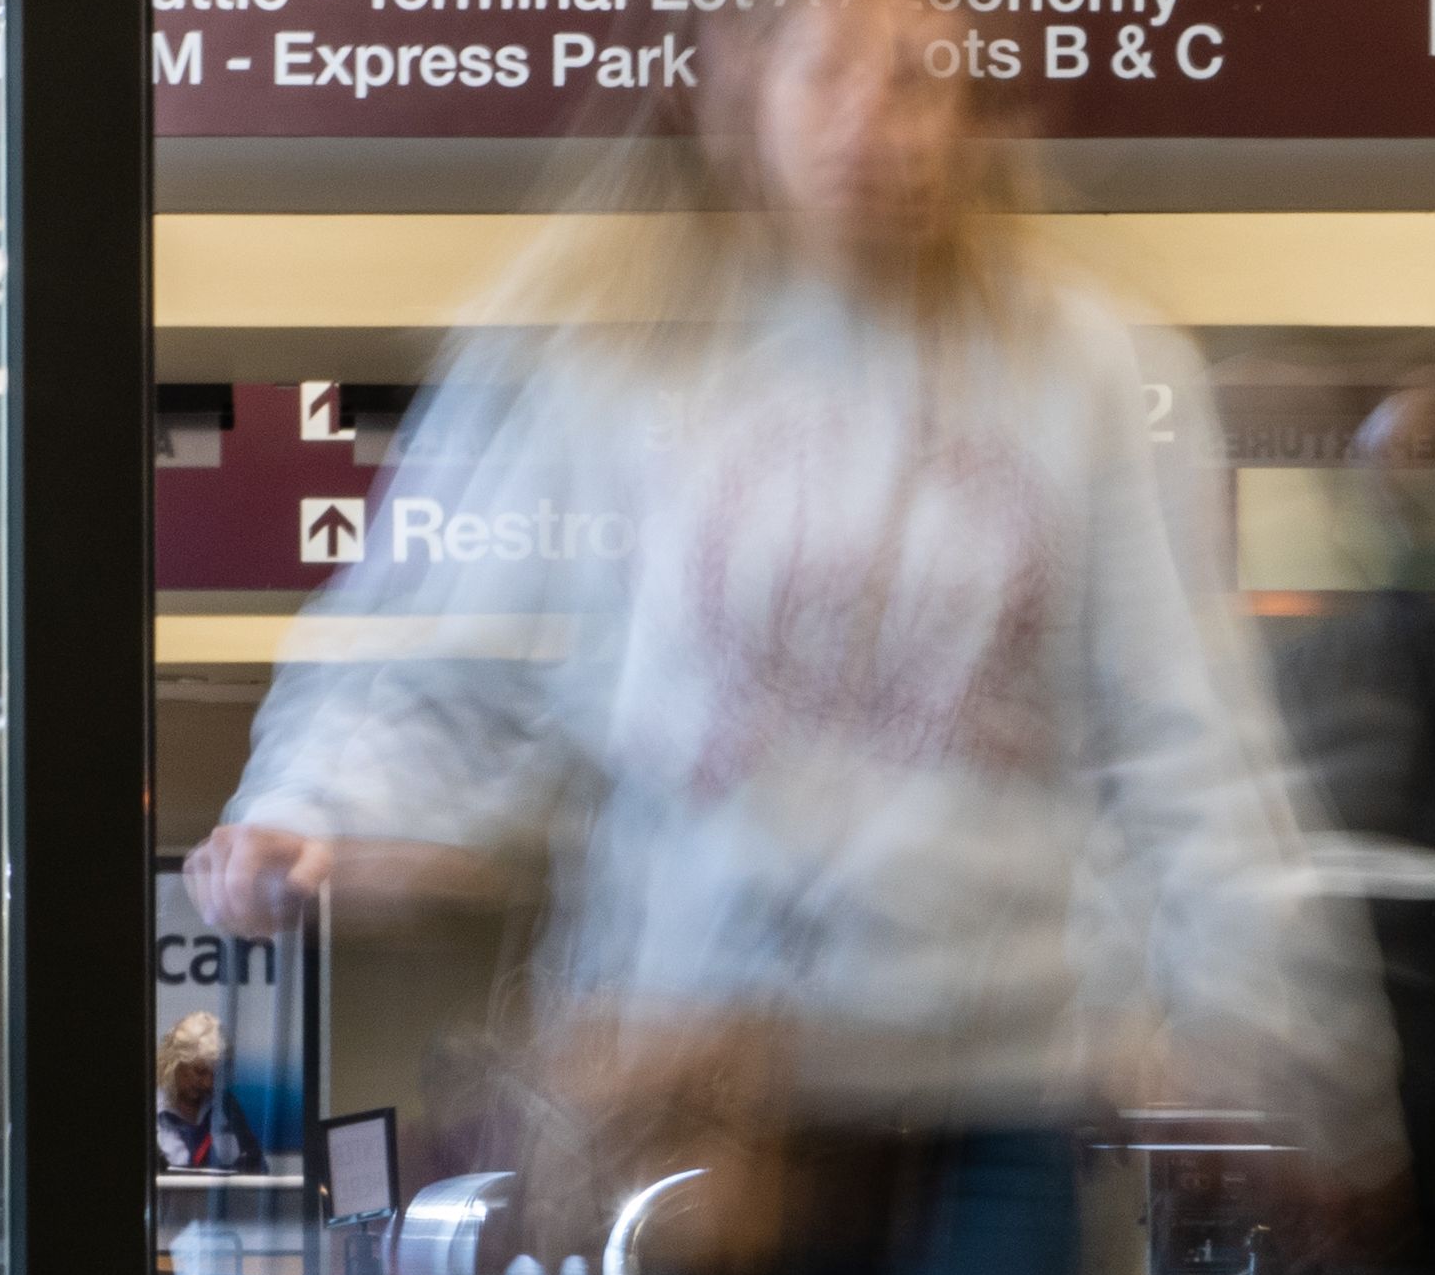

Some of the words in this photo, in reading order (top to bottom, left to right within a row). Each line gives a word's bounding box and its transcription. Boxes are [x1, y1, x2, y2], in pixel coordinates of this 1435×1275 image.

[274, 31, 530, 99] Express
[553, 33, 698, 88] Park
[922, 26, 1022, 80] ots
[1045, 25, 1091, 79] B
[1111, 24, 1157, 80] &
[1176, 24, 1225, 80] C
[391, 496, 635, 564] Restro
[156, 933, 276, 986] can
